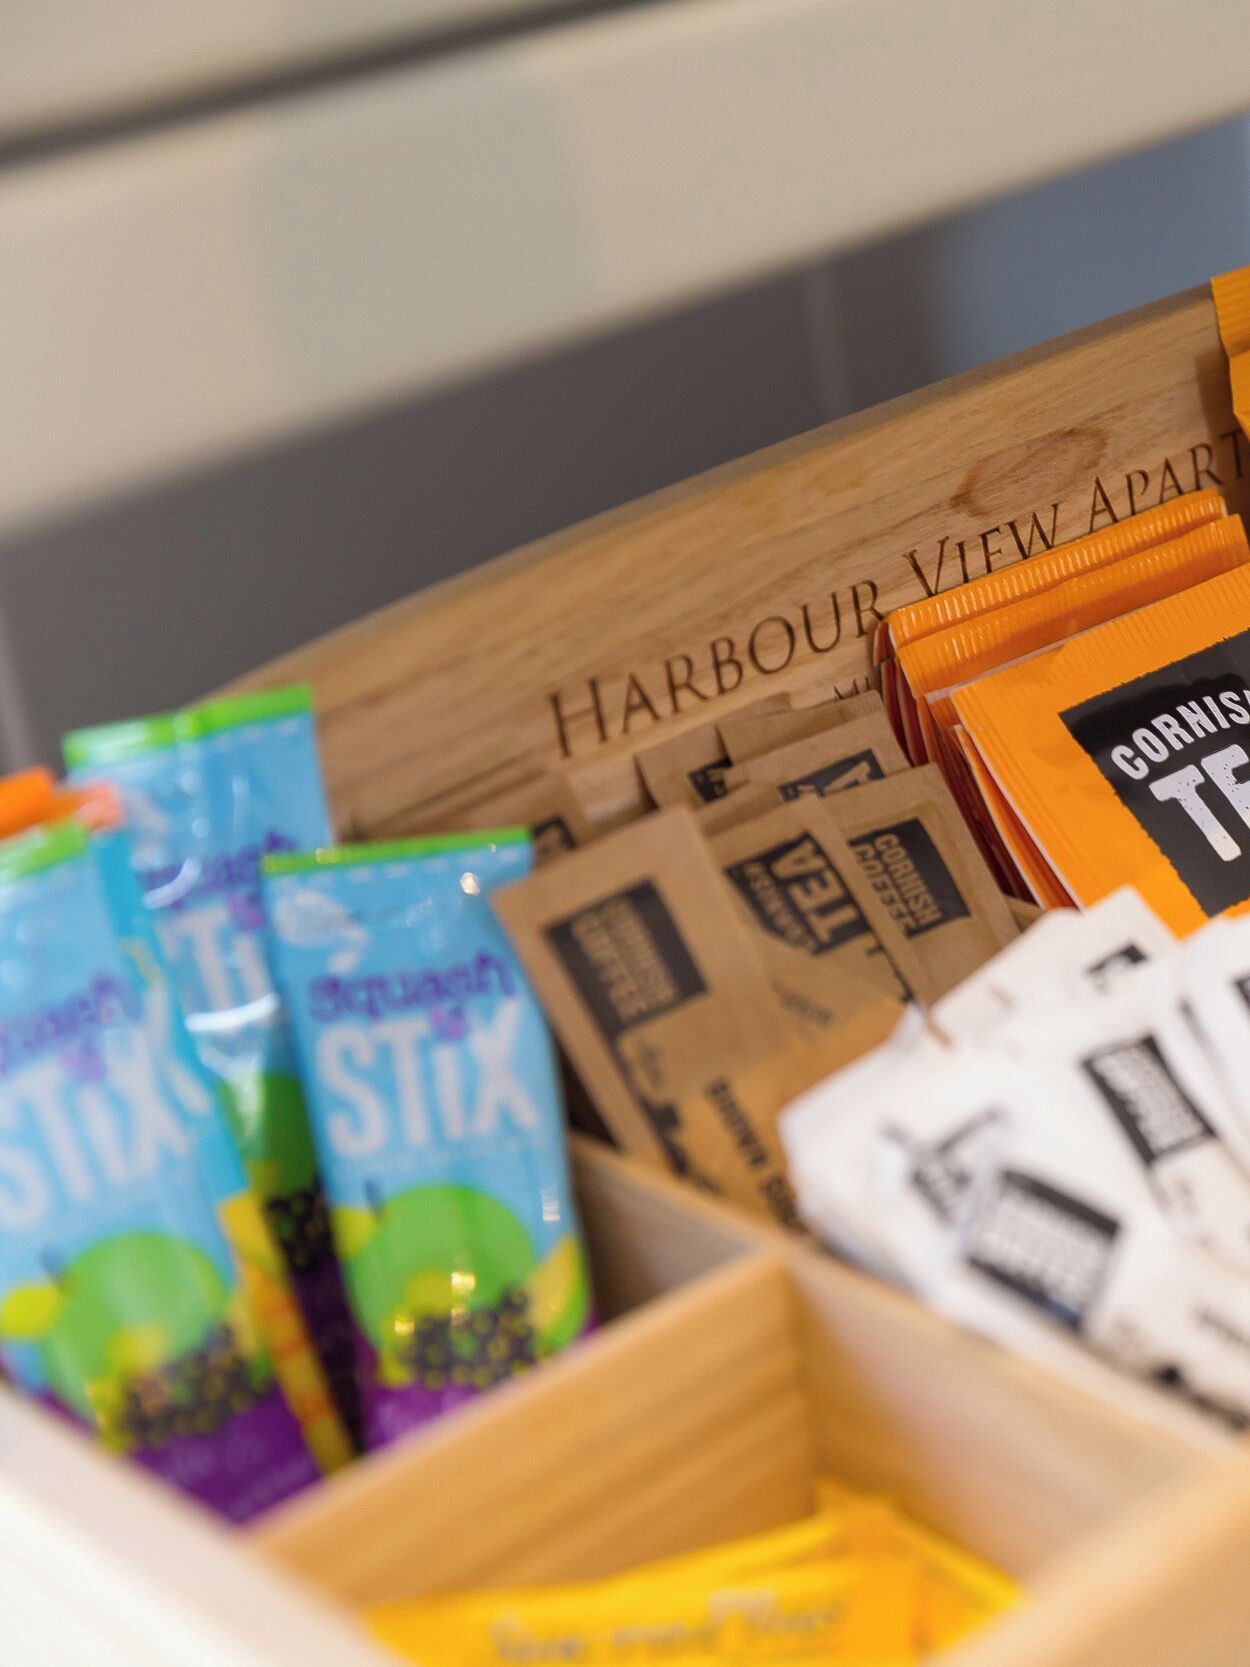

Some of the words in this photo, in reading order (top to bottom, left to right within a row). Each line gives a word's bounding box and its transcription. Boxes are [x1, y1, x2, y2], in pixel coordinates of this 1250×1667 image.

[549, 579, 884, 758] HARBOUR
[902, 502, 1059, 597] VIEW
[769, 839, 861, 945] TEA
[874, 833, 944, 927] CORNISH
